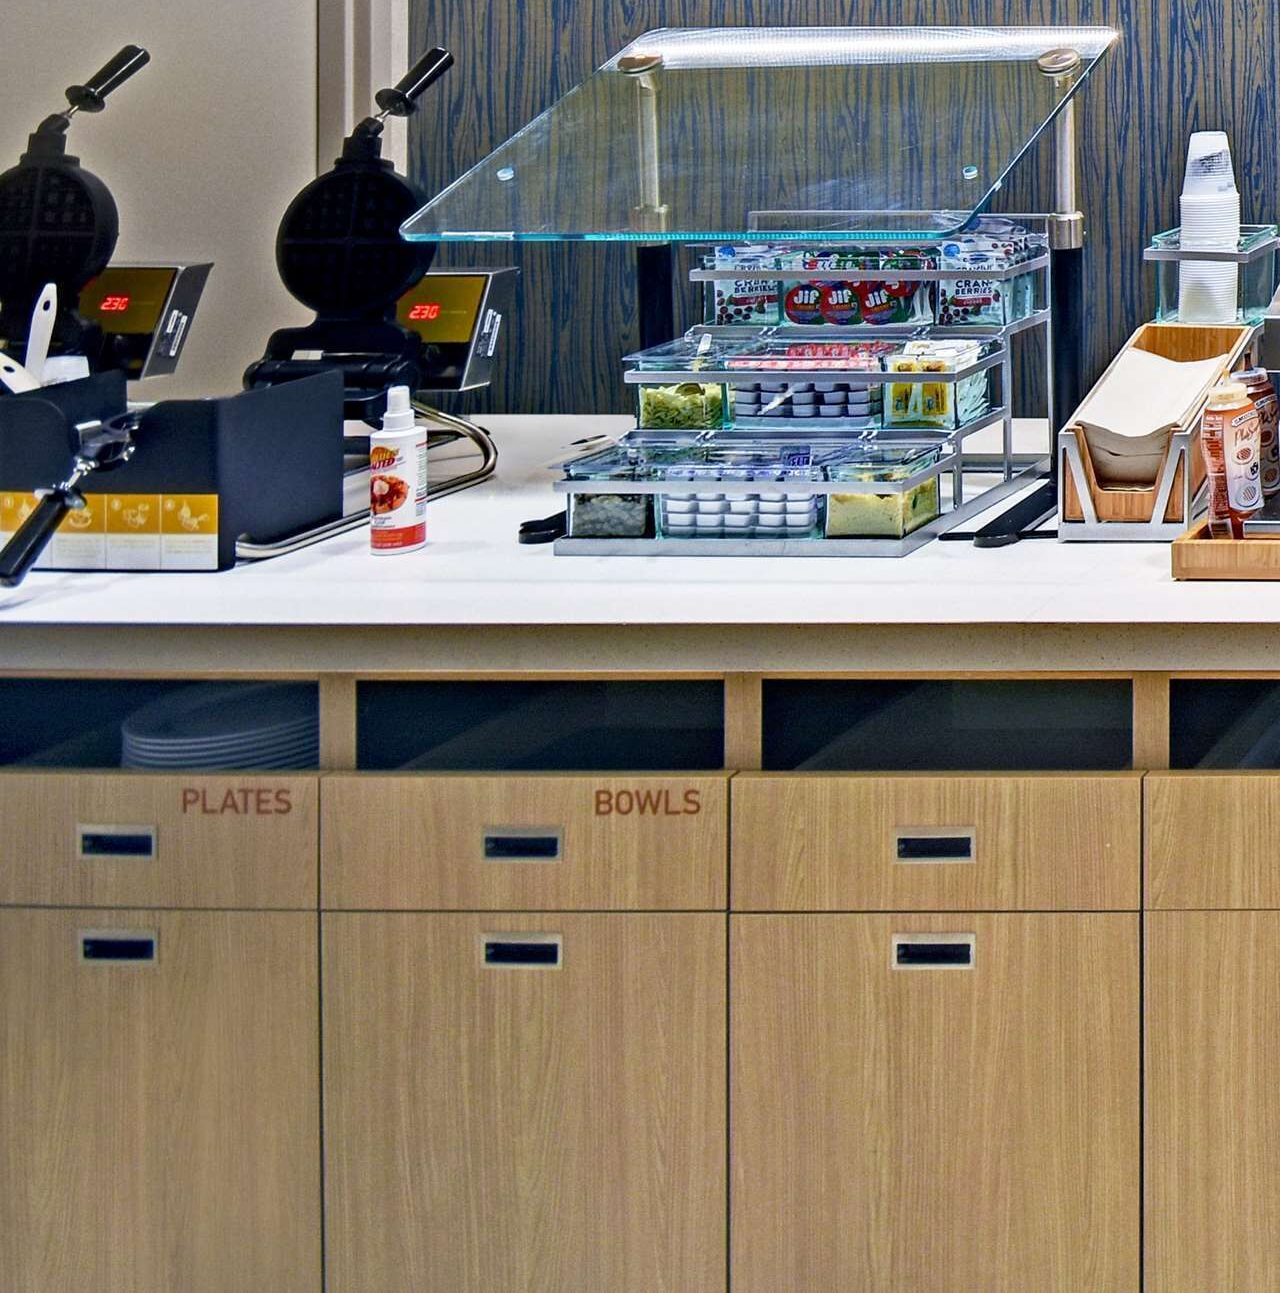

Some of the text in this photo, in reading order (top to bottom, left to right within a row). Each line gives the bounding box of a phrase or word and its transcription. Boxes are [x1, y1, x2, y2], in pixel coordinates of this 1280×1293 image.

[793, 287, 819, 305] Jif
[828, 289, 852, 305] Jif
[865, 289, 889, 307] Jif
[955, 287, 993, 296] BERRIES
[409, 305, 440, 320] 230
[182, 788, 293, 815] PLATES
[595, 789, 701, 815] BOWLS
